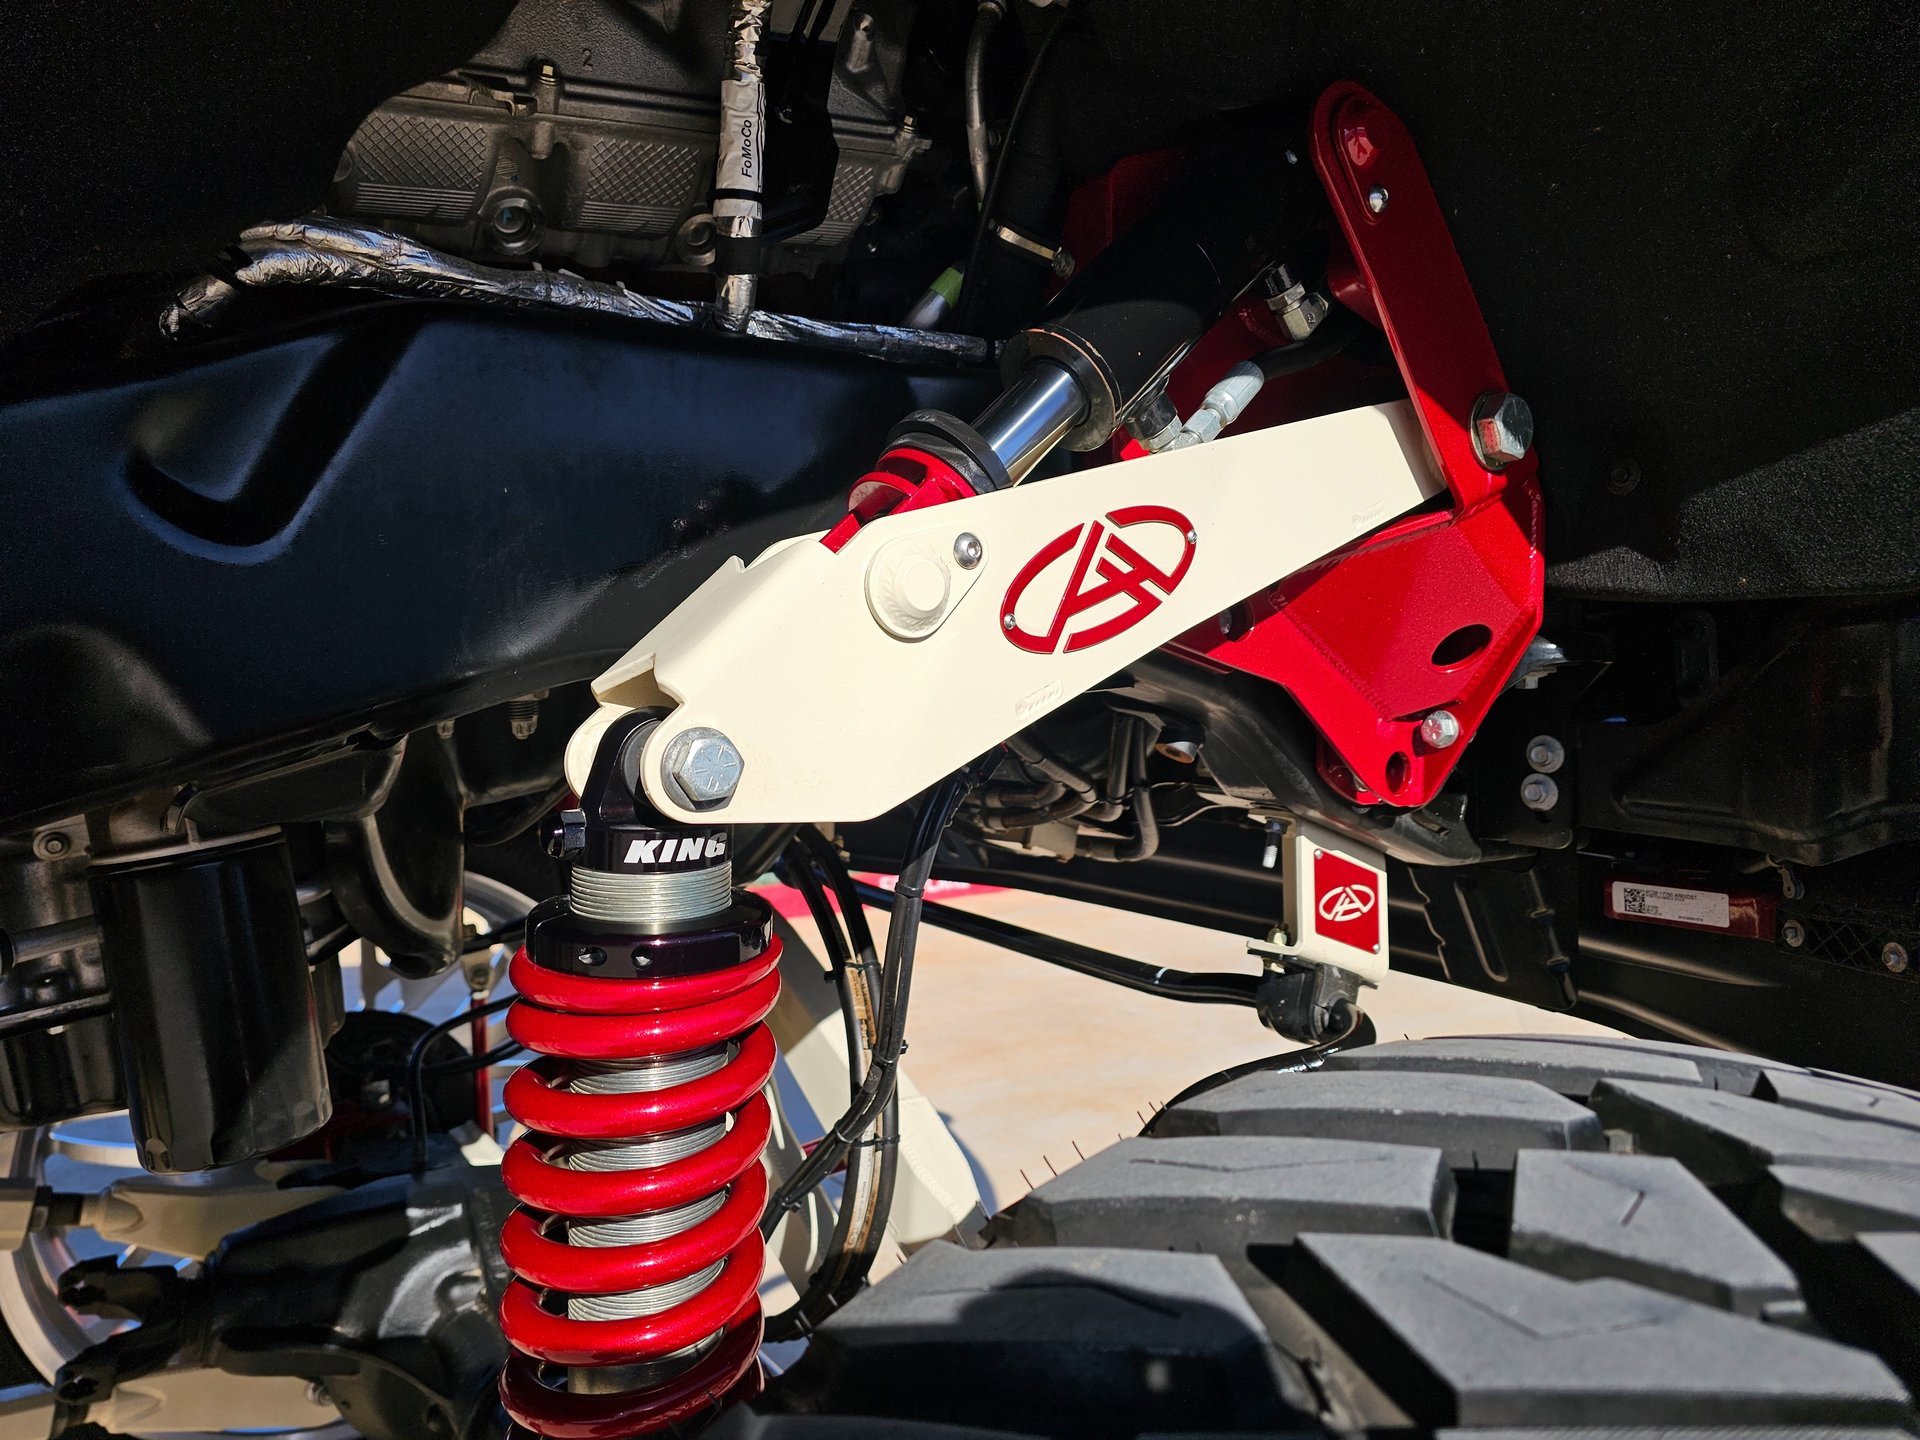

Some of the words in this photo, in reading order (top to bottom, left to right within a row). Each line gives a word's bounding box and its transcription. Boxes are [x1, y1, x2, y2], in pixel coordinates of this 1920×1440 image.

[582, 47, 593, 69] 2
[741, 119, 752, 178] FoMoCo
[623, 832, 728, 864] KING
